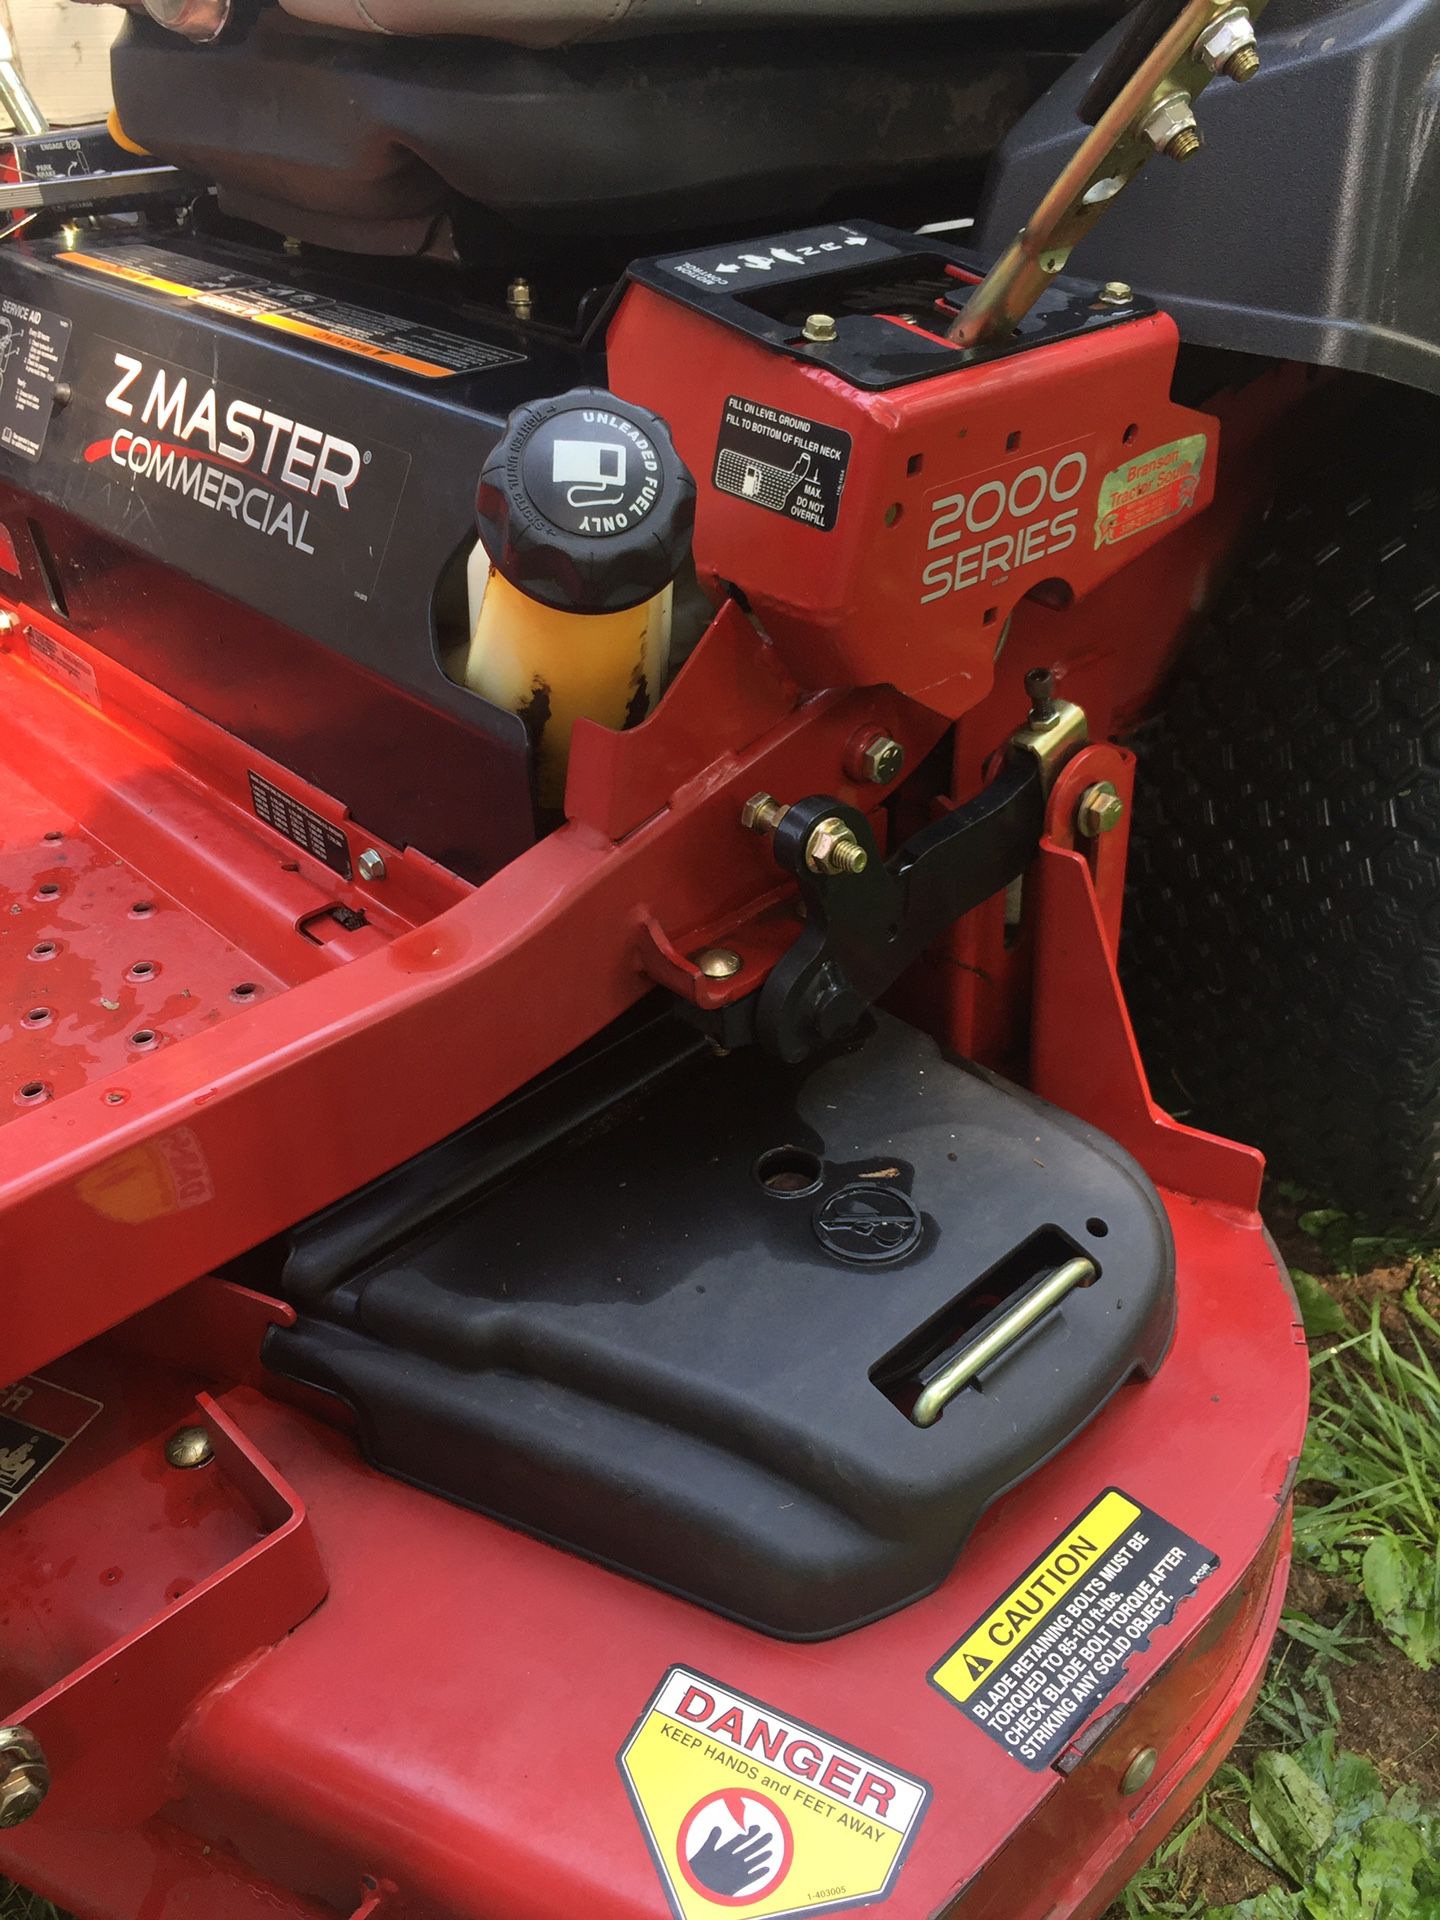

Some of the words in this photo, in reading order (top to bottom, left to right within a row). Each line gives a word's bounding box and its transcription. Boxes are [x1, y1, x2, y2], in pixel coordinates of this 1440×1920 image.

[674, 265, 716, 285] MOTION
[2, 300, 29, 321] SERVICE
[28, 310, 41, 325] AID
[105, 353, 142, 416] Z
[141, 369, 361, 510] MASTER
[510, 411, 548, 454] TIGHTEN
[726, 413, 740, 427] FILL
[742, 418, 752, 430] TO
[752, 422, 781, 440] BOTTOM
[782, 432, 793, 444] OF
[794, 436, 819, 454] FILLER
[820, 446, 842, 460] NECK
[729, 398, 742, 411] FILL
[744, 403, 755, 415] ON
[755, 408, 777, 422] LEVEL
[779, 414, 811, 433] GROUND
[582, 412, 658, 471] UNLEADED
[507, 456, 520, 490] UNTIL
[1127, 450, 1180, 483] Branson
[110, 428, 315, 555] COMMERCIAL
[513, 493, 545, 531] CLICKS
[628, 476, 658, 517] FUEL
[797, 496, 808, 508] DO
[809, 501, 825, 514] NOT
[804, 484, 822, 499] MAX.
[927, 452, 1087, 550] 2000
[579, 512, 628, 532] ONLY
[790, 505, 825, 527] OVERFILL
[920, 508, 1079, 604] SERIES
[988, 1535, 1098, 1647] CAUTION
[972, 1673, 1018, 1720] BLADE
[1010, 1614, 1074, 1679] RETAINING
[1065, 1578, 1106, 1618] BOLTS
[1099, 1547, 1134, 1582] MUST
[1127, 1531, 1150, 1552] BE
[1004, 1697, 1050, 1745] CHECK
[1042, 1657, 1087, 1702] BLADE
[1078, 1625, 1113, 1662] BOLT
[1106, 1580, 1156, 1629] TORQUE
[1148, 1546, 1187, 1586] AFTER
[987, 1670, 1047, 1732] TORQUED
[1040, 1653, 1063, 1672] TO
[1057, 1617, 1096, 1656] 85-110
[1088, 1591, 1124, 1622] ft-lbs.
[1020, 1698, 1079, 1759] STRIKING
[1071, 1670, 1099, 1702] ANY
[1093, 1636, 1131, 1675] SOLID
[1125, 1590, 1174, 1639] OBJECT.
[675, 1685, 896, 1818] DANGER
[660, 1722, 702, 1750] KEEP
[704, 1745, 760, 1780] HANDS
[761, 1774, 791, 1796] and
[793, 1790, 836, 1818] FEET
[837, 1813, 887, 1844] AWAY
[807, 1886, 847, 1901] 1-403005
